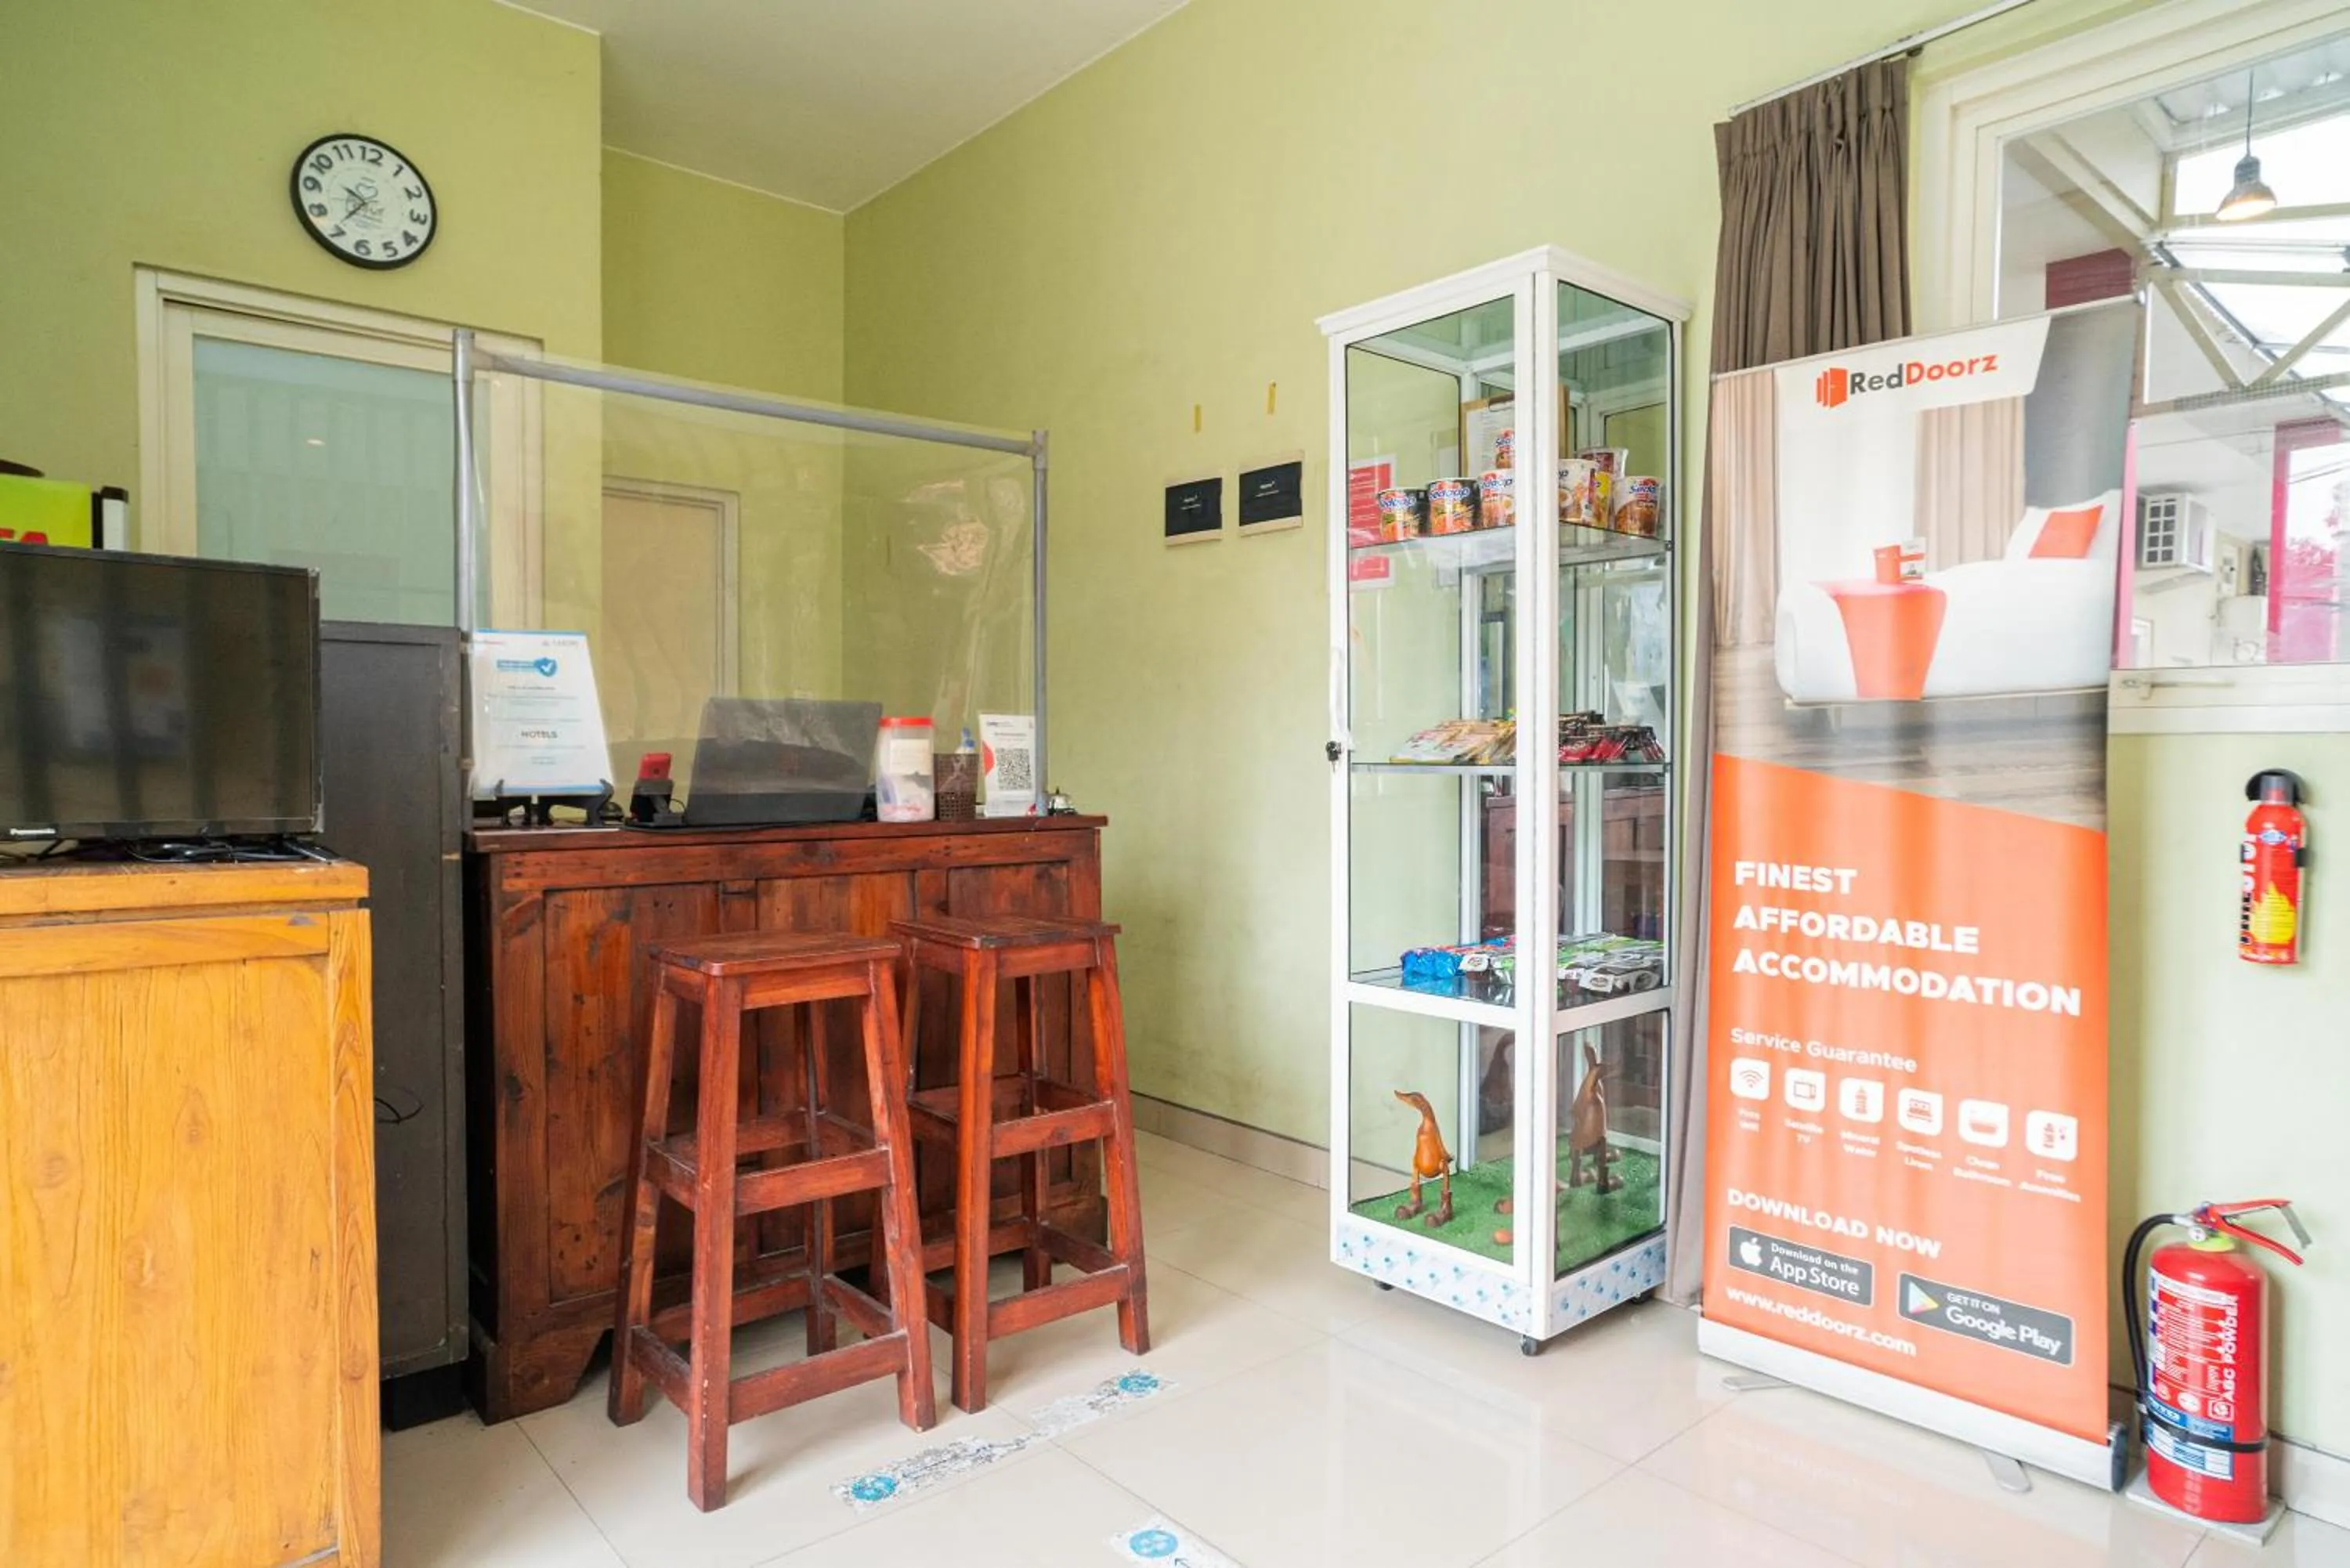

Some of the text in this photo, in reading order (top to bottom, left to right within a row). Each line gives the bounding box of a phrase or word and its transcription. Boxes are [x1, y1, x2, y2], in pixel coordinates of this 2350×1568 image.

[332, 143, 354, 161] 11
[359, 145, 384, 166] 12
[309, 154, 333, 175] 10
[392, 164, 403, 177] 1
[303, 176, 323, 193] 9
[404, 186, 422, 201] 2
[309, 204, 327, 218] 8
[409, 210, 428, 226] 3
[329, 225, 346, 239] 7
[403, 230, 419, 247] 4
[354, 240, 371, 256] 6
[381, 241, 399, 258] 5
[1850, 355, 1998, 394] RedDoorz
[1734, 860, 1857, 894] FINEST
[1733, 905, 1979, 955] AFFORDABLE
[1732, 948, 2081, 1017] ACCOMMODATION
[1730, 1027, 1917, 1074] Service Guarantee
[1727, 1188, 1942, 1259] DOWNLOAD NOW
[1771, 1242, 1859, 1275] Download on the
[1770, 1256, 1860, 1296] App Store
[1947, 1292, 2001, 1314] GET IT ON
[1725, 1288, 1917, 1357] www.reddoorz.com
[1946, 1306, 2062, 1356] Google Play
[2222, 1367, 2236, 1402] ABC
